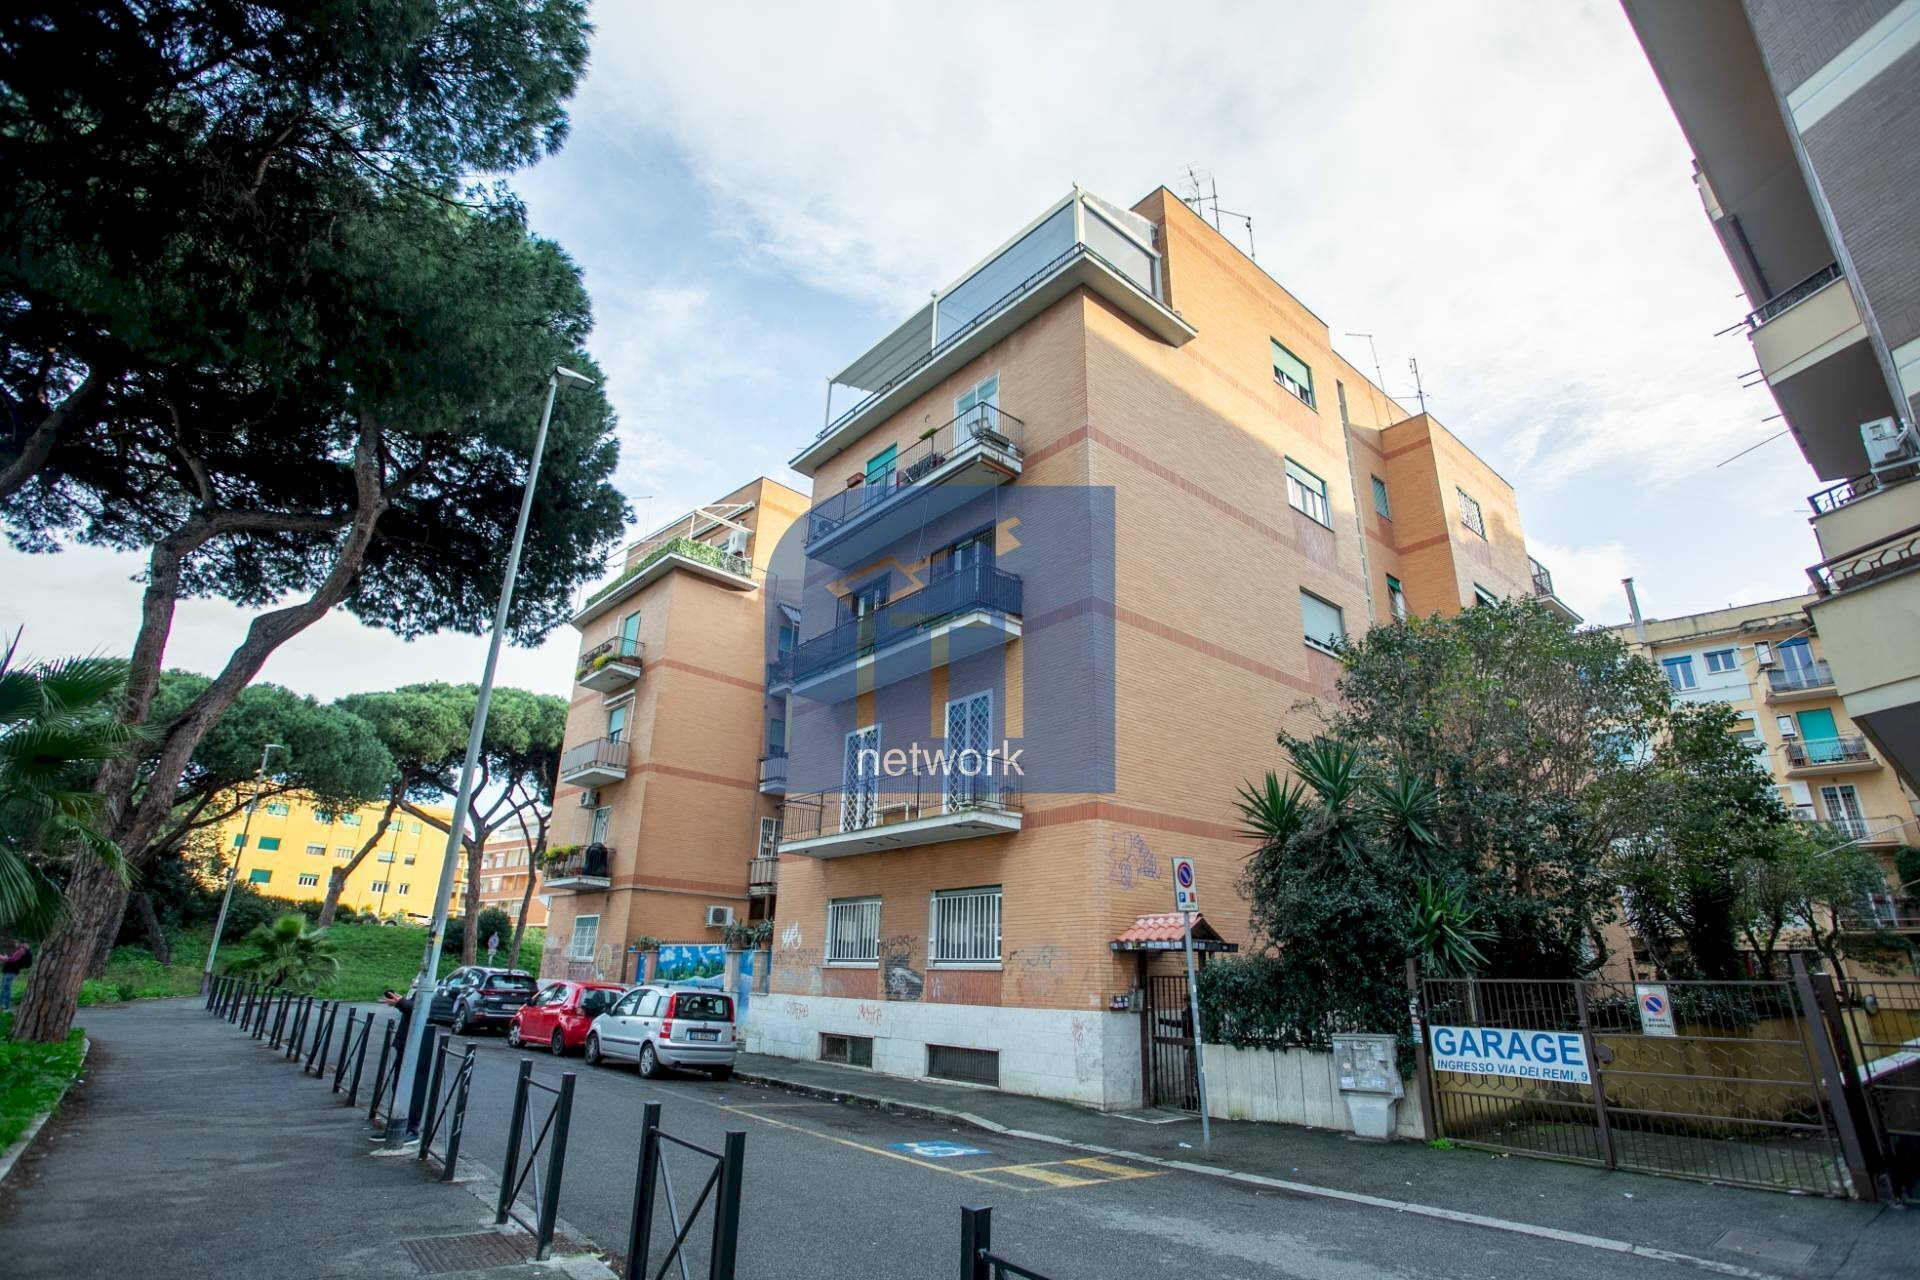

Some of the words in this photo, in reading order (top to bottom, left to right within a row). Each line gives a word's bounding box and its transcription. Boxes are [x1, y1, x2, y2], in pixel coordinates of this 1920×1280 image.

[1434, 1028, 1584, 1066] GARAGE
[1437, 1059, 1494, 1073] INGRESSO
[1497, 1063, 1516, 1074] VIA
[1519, 1066, 1539, 1077] DEI
[1542, 1068, 1577, 1082] REMI,
[1580, 1071, 1588, 1082] 9
